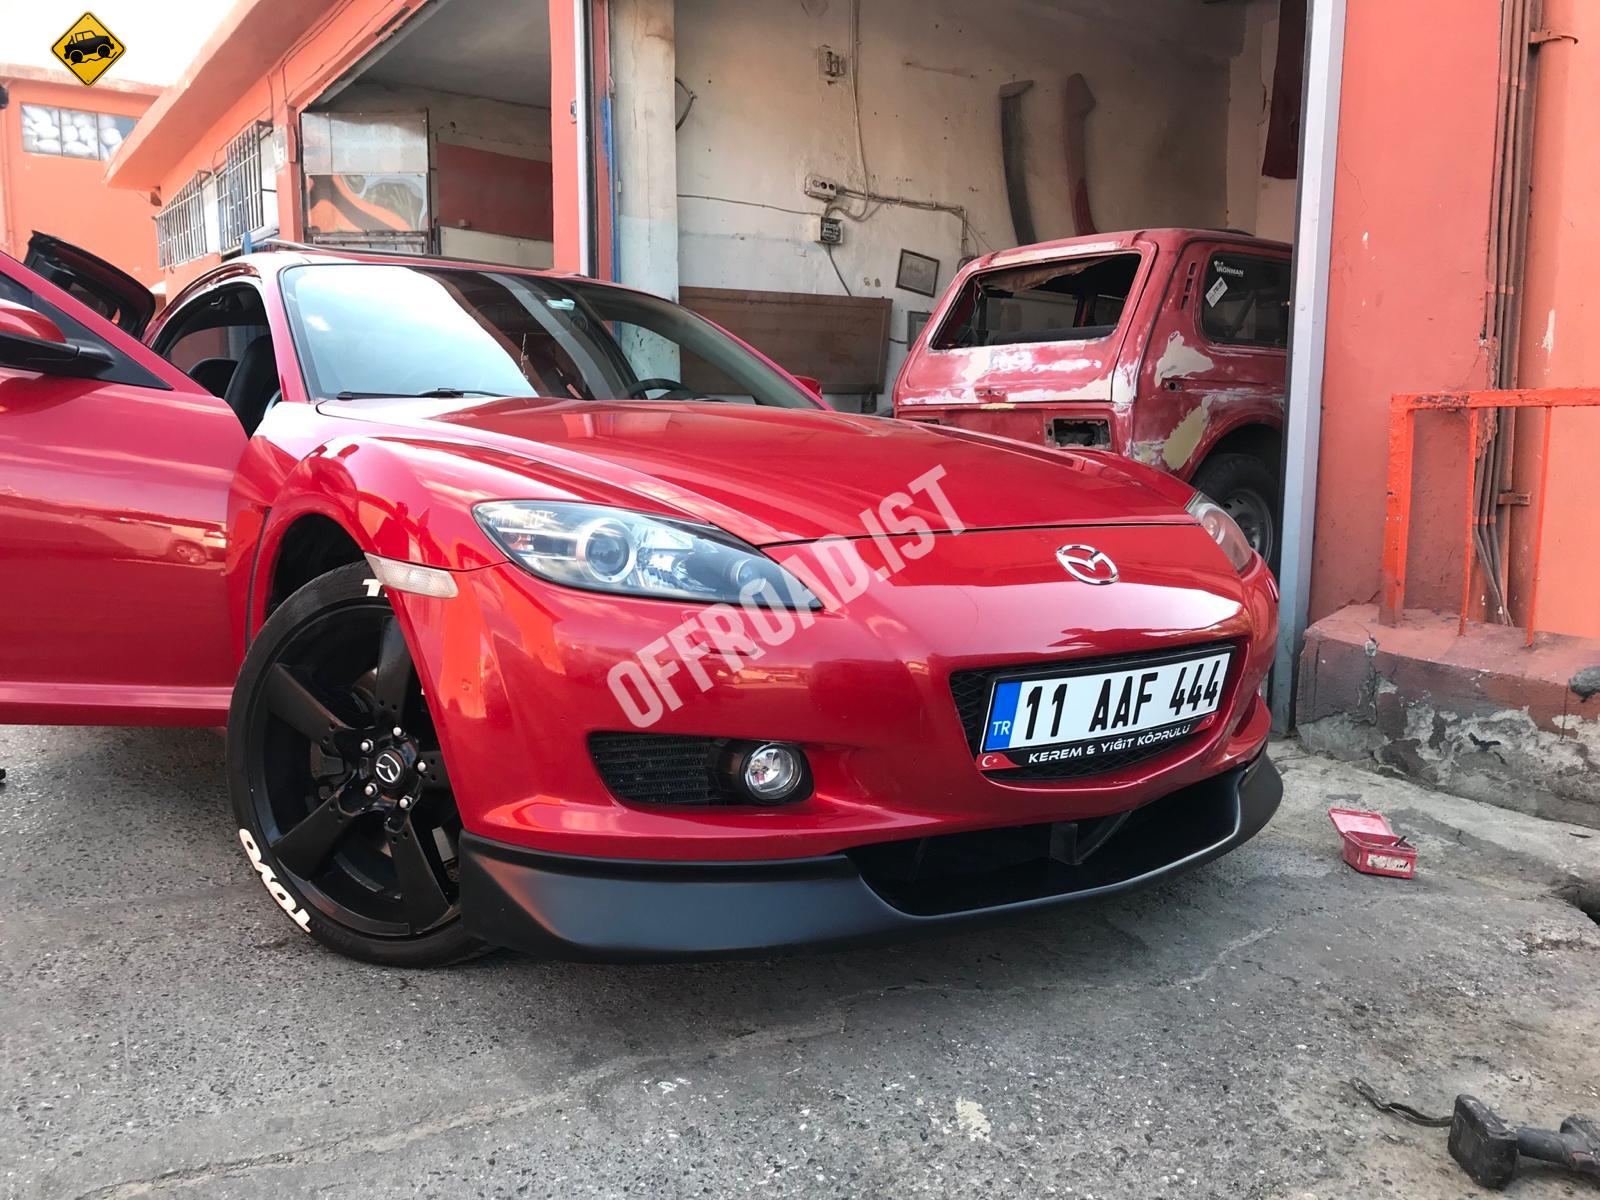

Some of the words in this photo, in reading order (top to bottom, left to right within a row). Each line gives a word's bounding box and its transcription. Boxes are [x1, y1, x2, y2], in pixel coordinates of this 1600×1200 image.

[1216, 266, 1244, 277] IRONMAN
[1025, 683, 1068, 740] 11
[1088, 672, 1158, 732] AAF
[1169, 660, 1221, 716] 444
[993, 720, 1012, 736] TR
[1028, 746, 1082, 764] KEREM
[1086, 744, 1096, 755] &
[239, 828, 311, 933] TOYO
